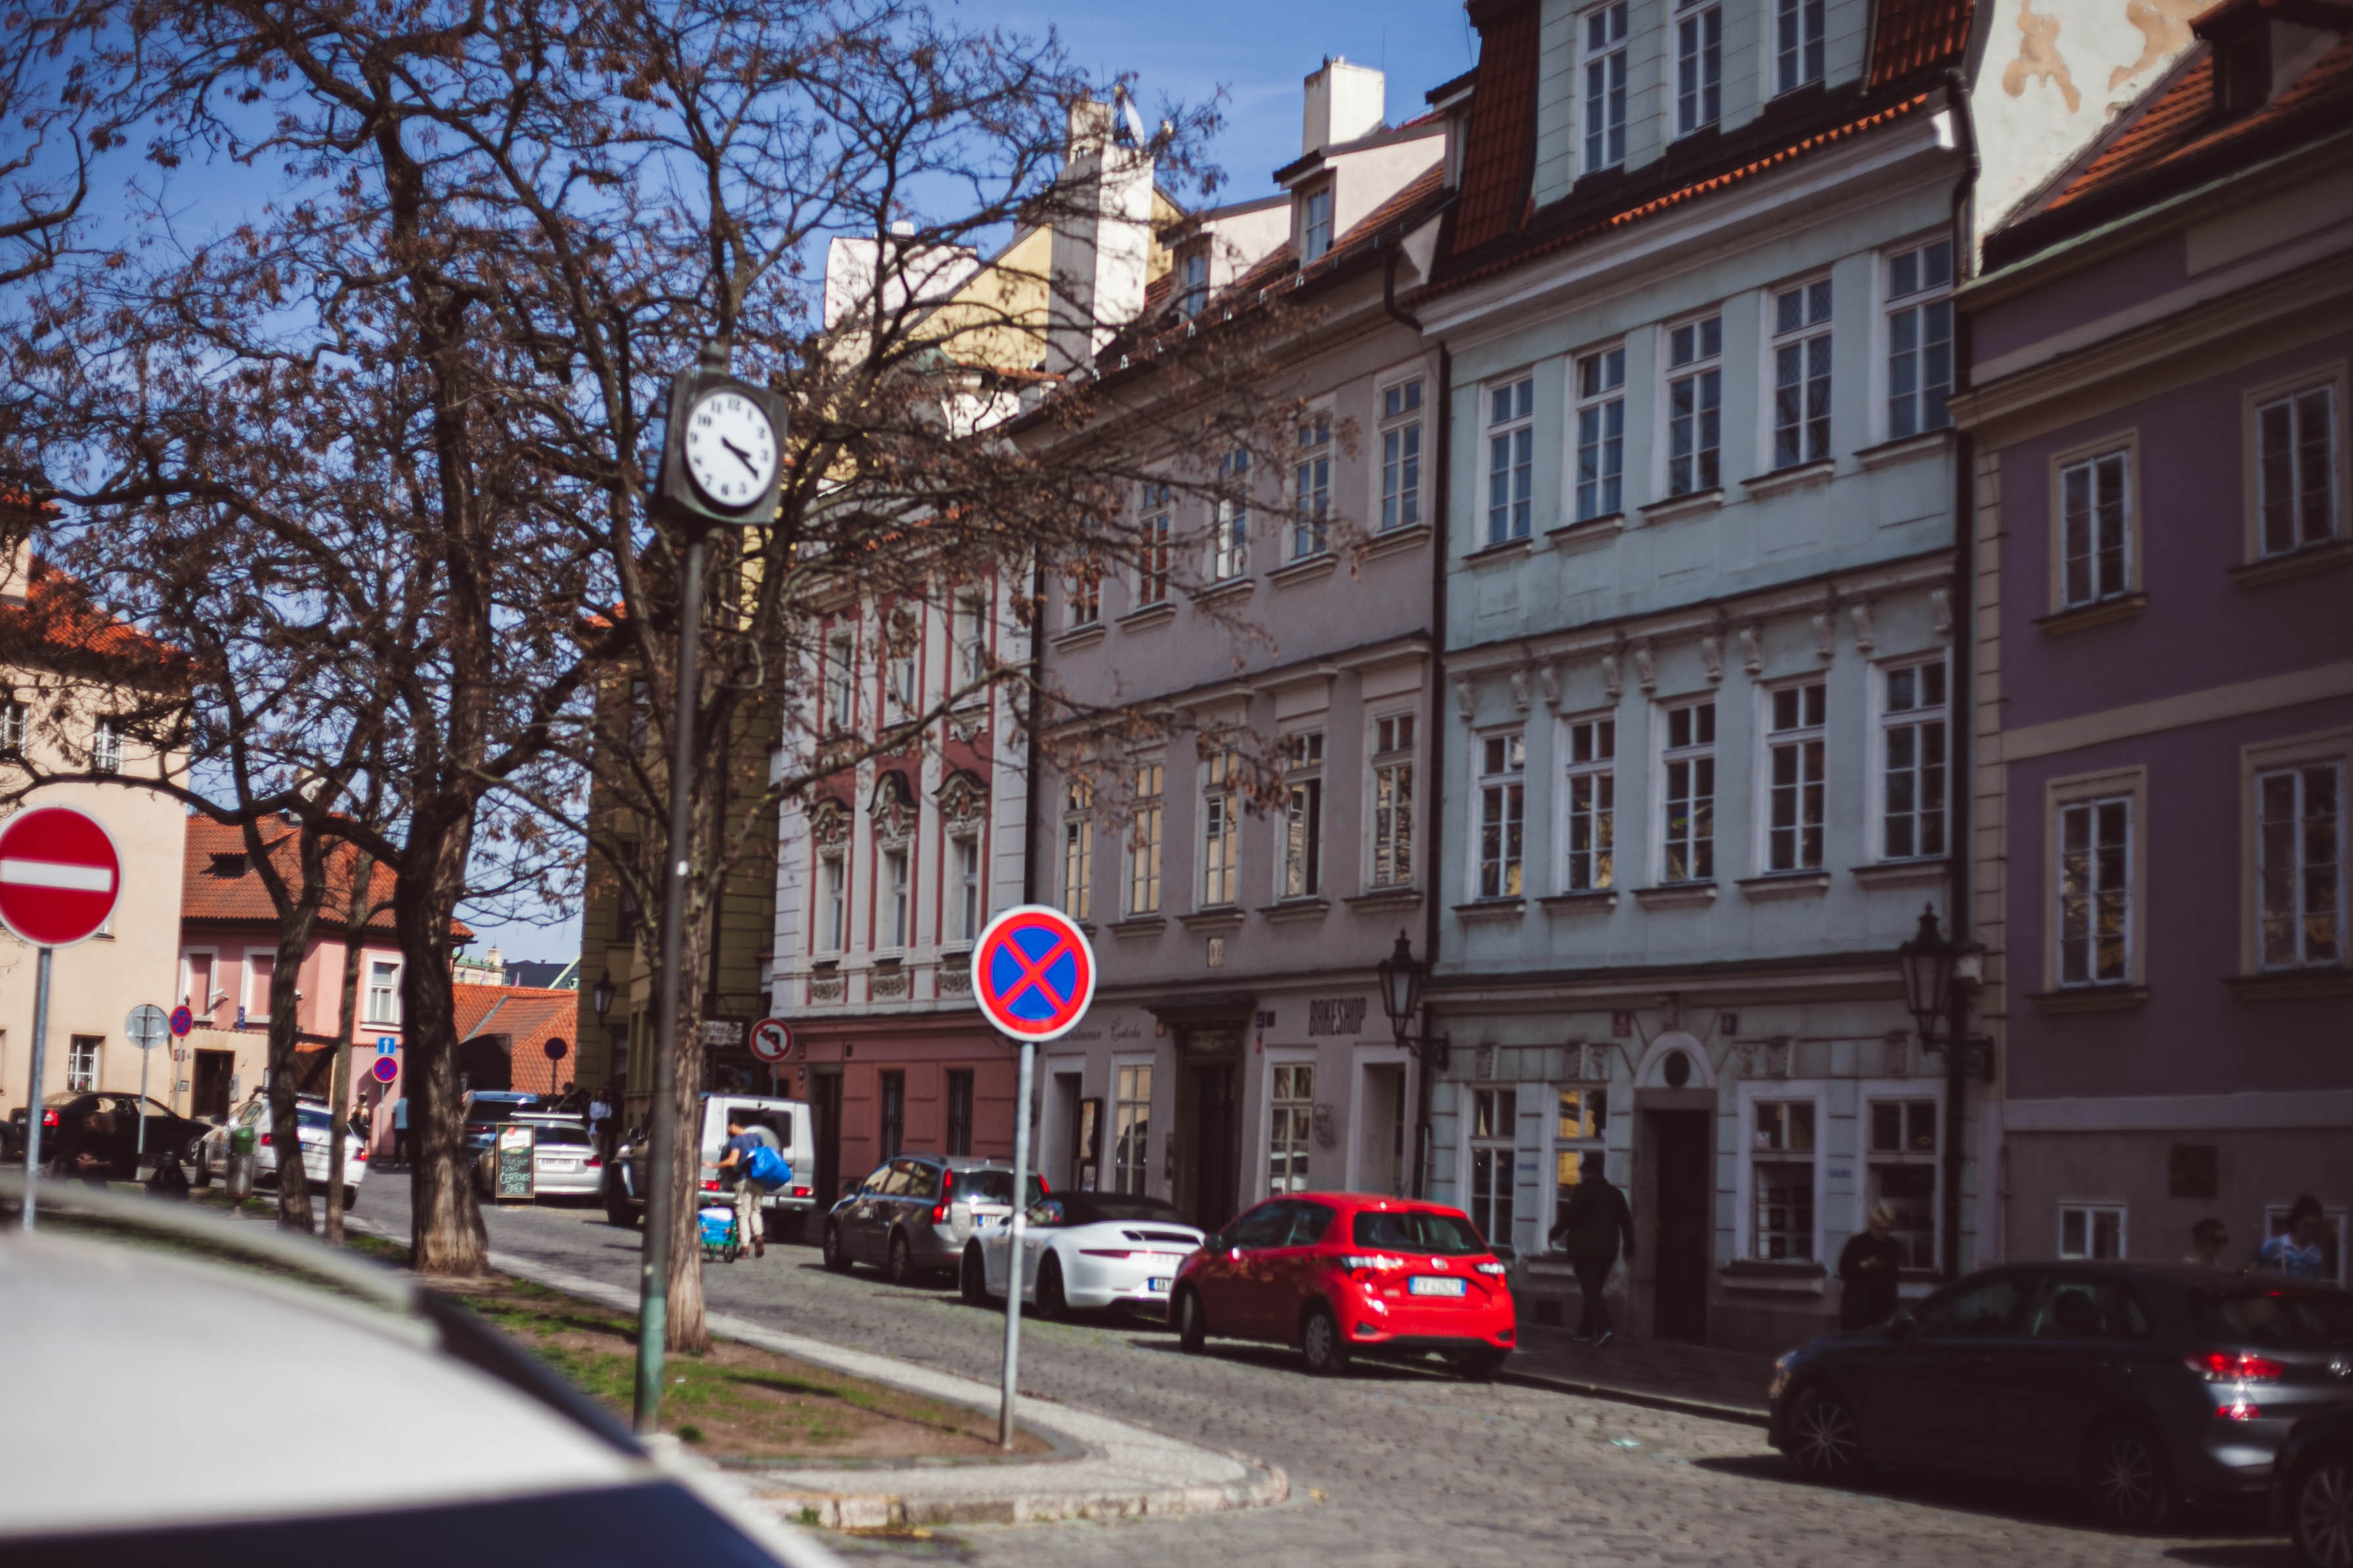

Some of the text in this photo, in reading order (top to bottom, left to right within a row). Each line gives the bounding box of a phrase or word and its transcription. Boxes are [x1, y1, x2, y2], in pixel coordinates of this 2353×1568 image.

[711, 398, 722, 414] 11
[727, 396, 741, 412] 12
[697, 414, 712, 427] 10
[757, 427, 766, 439] 2
[704, 473, 713, 487] 7
[1308, 997, 1366, 1037] BAKESHOP
